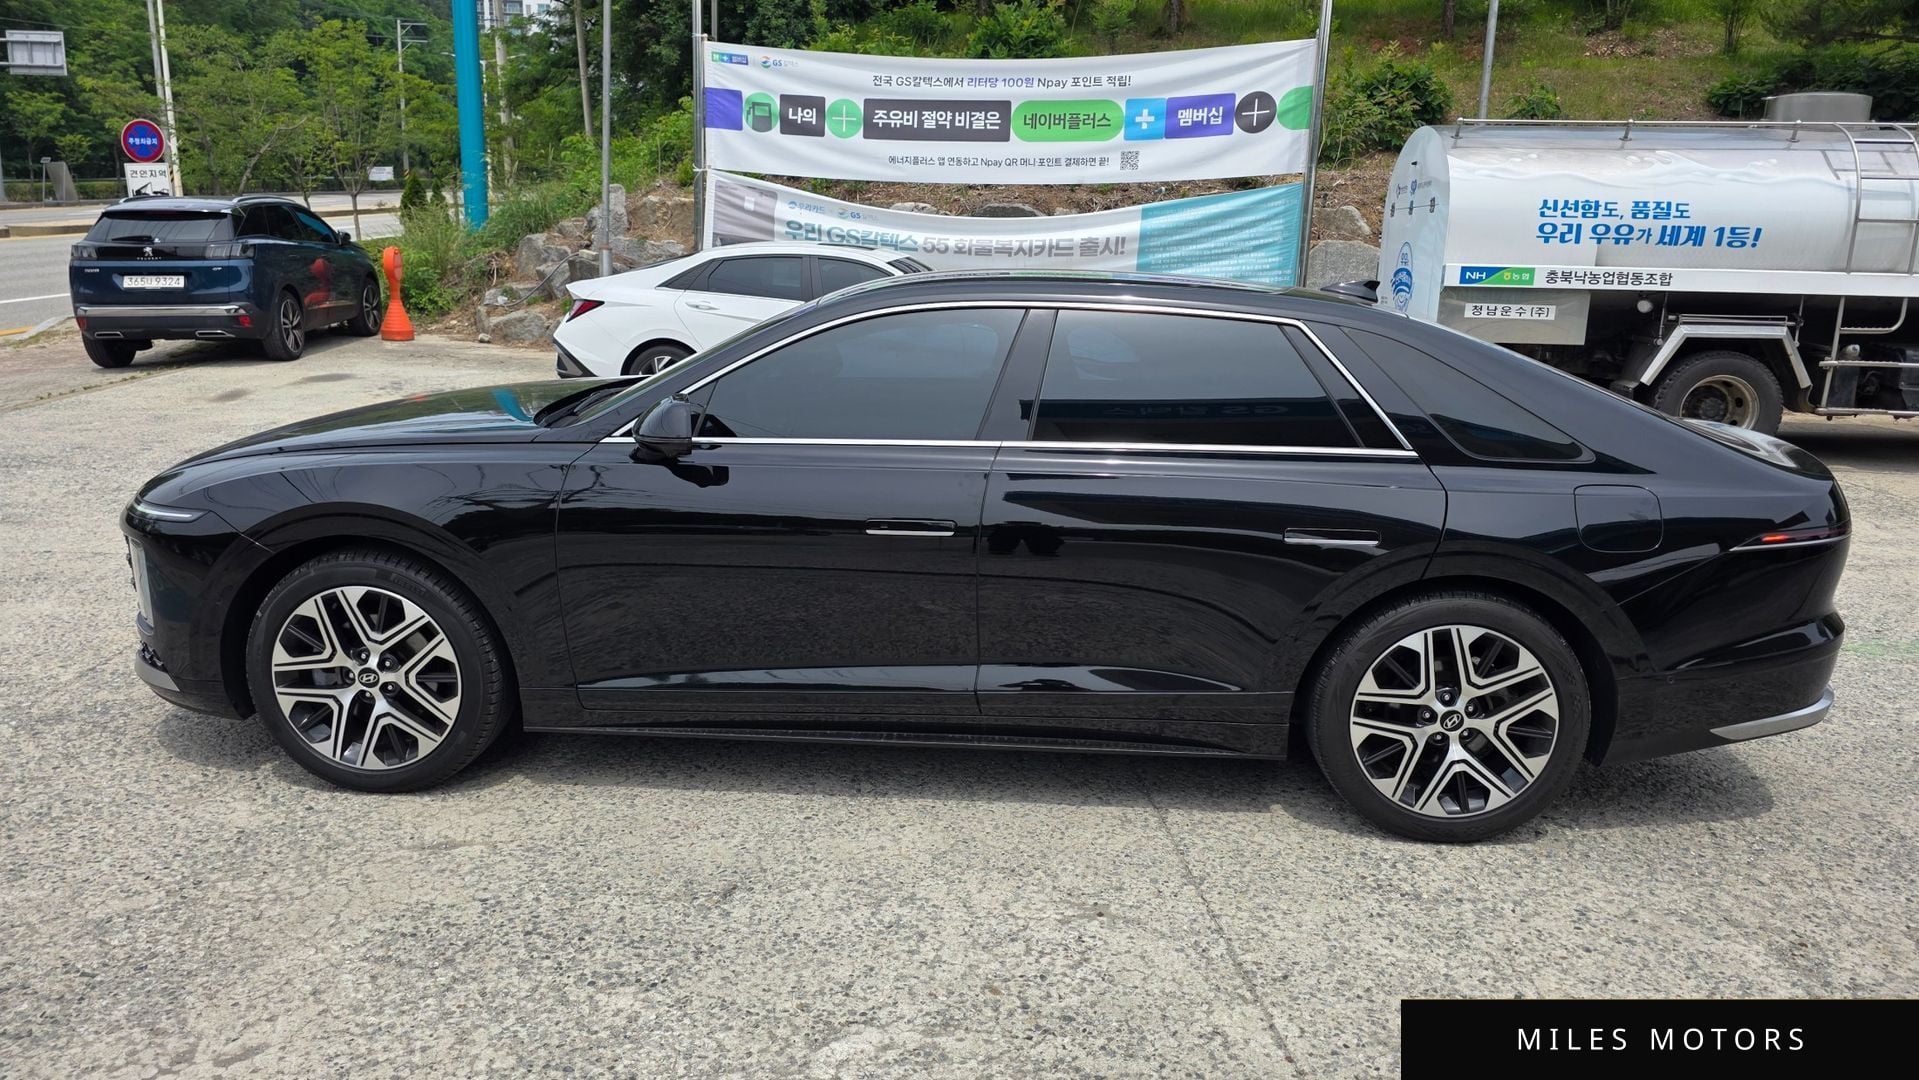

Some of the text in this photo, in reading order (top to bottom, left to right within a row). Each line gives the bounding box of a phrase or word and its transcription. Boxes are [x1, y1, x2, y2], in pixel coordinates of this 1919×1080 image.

[872, 75, 1131, 89] 전국 GS칼텍스에서 리터당 100원 Npay 포인트 적립!
[788, 107, 817, 125] 나의
[872, 110, 1001, 130] 주유비 절약 비결은
[1023, 112, 1111, 130] 네이버플러스
[1177, 106, 1224, 128] 멤버십
[888, 155, 936, 166] 에너지플러스
[947, 157, 979, 167] 연동하고
[980, 158, 1003, 168] Npay
[1004, 158, 1018, 167] QR
[1064, 157, 1097, 167] 결제하면
[129, 169, 167, 178] 견인지역
[850, 211, 861, 219] GS
[1538, 199, 1691, 220] 신선함도, 품질도
[785, 220, 1126, 258] 우리 GS칼텍스 55 화물복지카드 출시!
[1536, 222, 1763, 249] 우리 우유가 세계 1등!
[155, 277, 180, 286] 9324
[1465, 271, 1487, 280] NH
[1545, 270, 1673, 287] 충북낙농업협동조합
